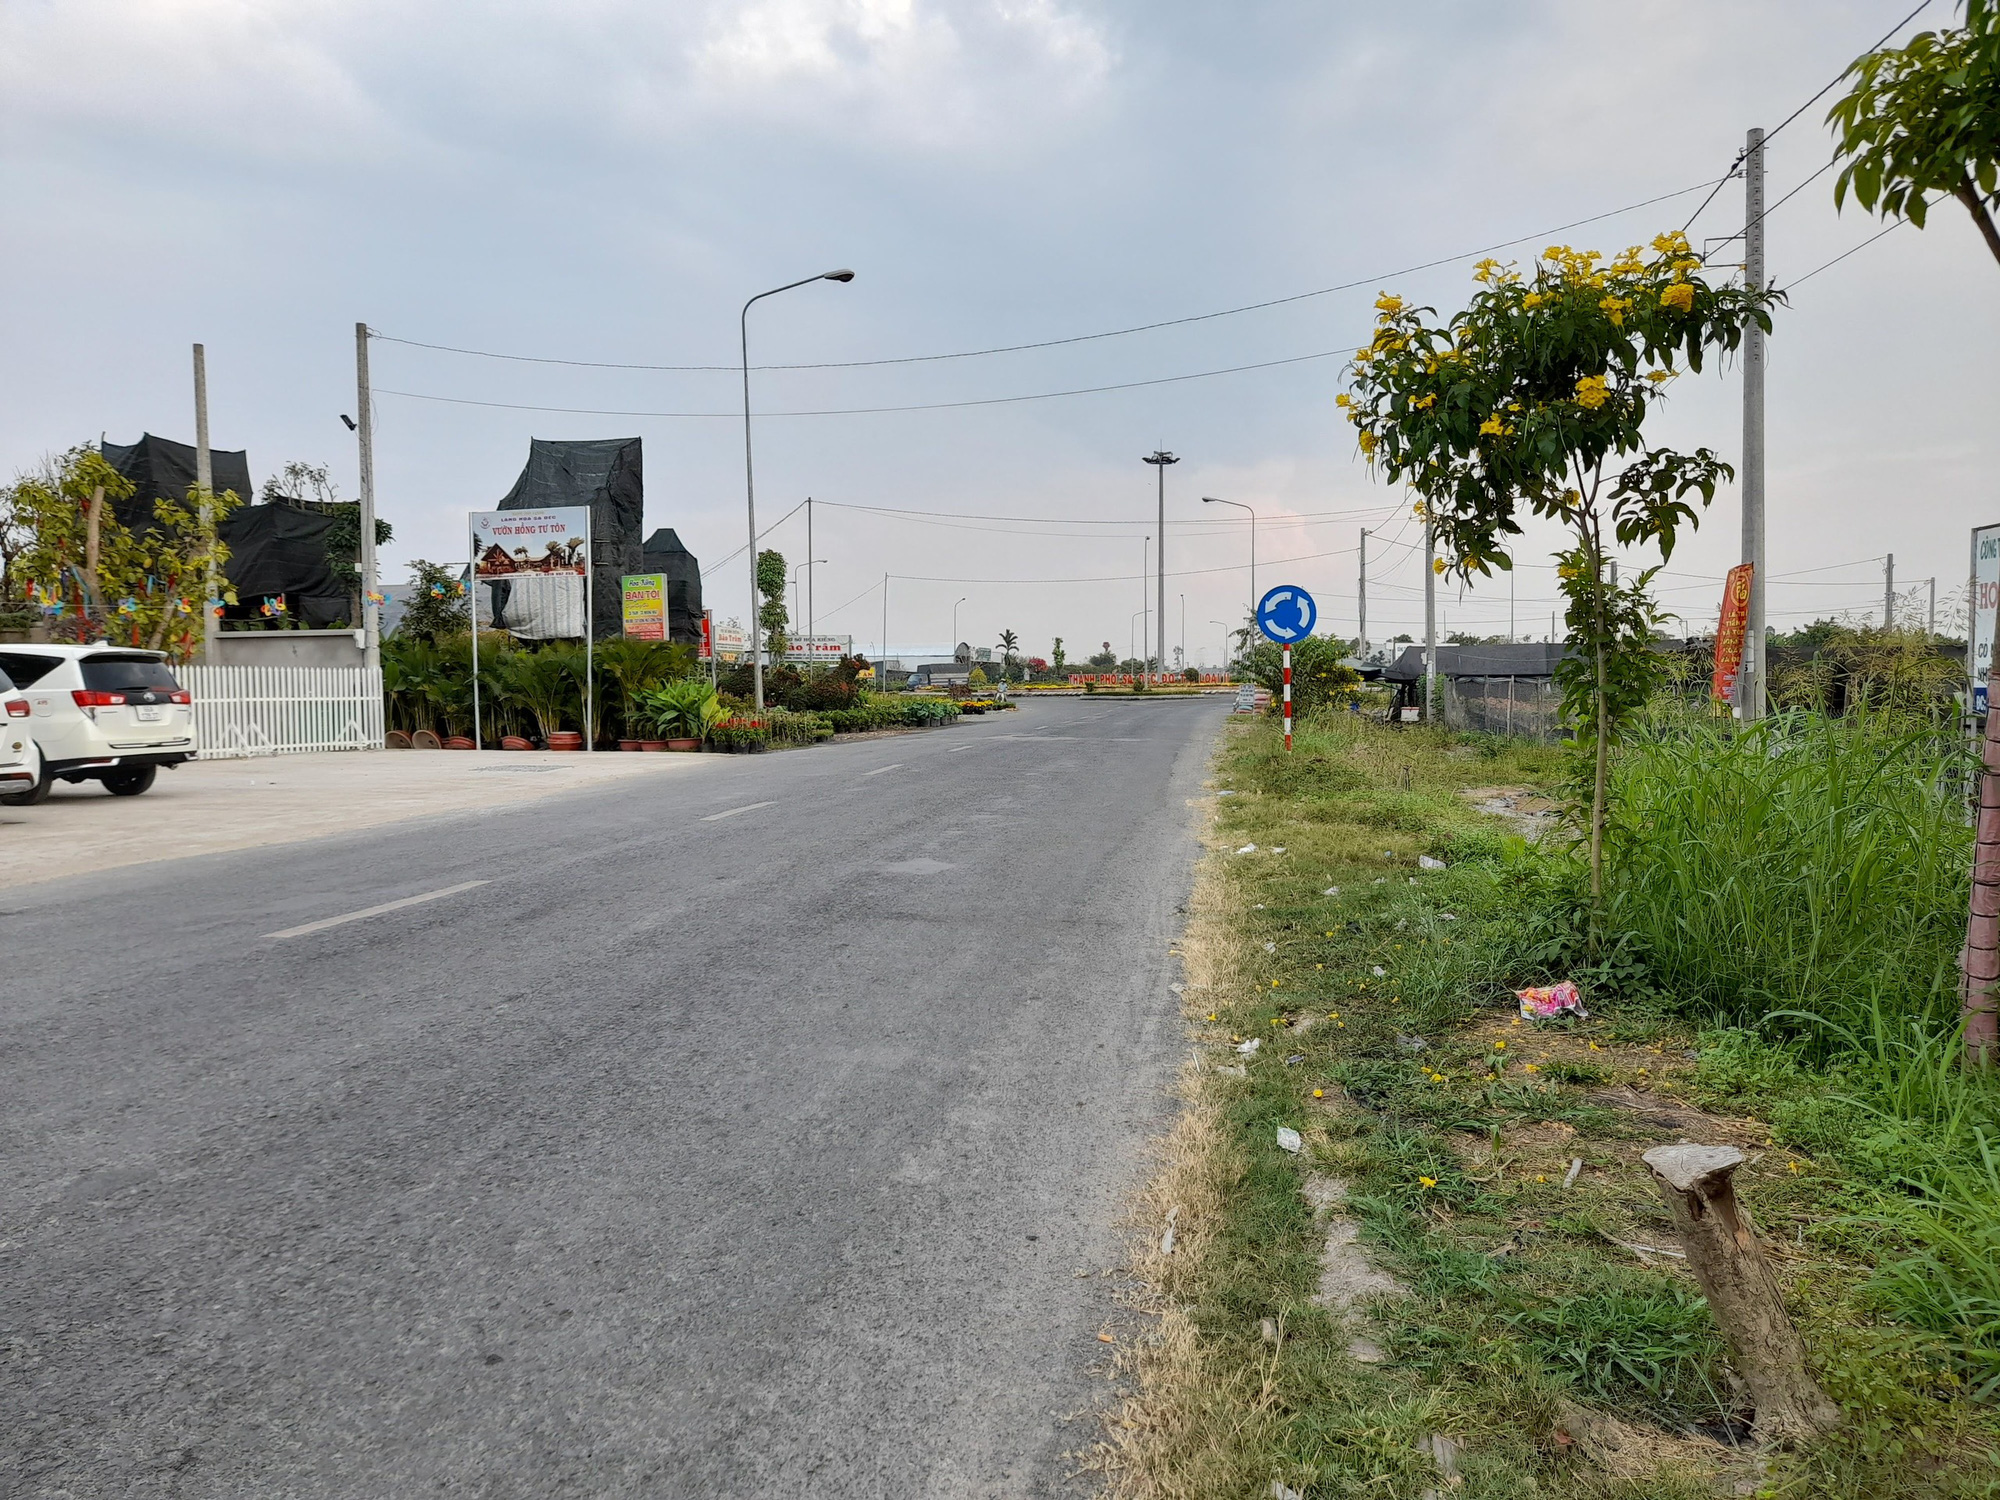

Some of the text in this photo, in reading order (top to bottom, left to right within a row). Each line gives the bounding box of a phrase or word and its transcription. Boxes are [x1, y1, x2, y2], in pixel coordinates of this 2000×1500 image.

[492, 525, 513, 536] VƯỜN
[514, 522, 536, 535] HỒNG
[538, 524, 549, 533] TƯ
[1980, 535, 1997, 560] CÔNG
[1979, 581, 1998, 610] HO
[788, 642, 841, 651] ảo Trâm
